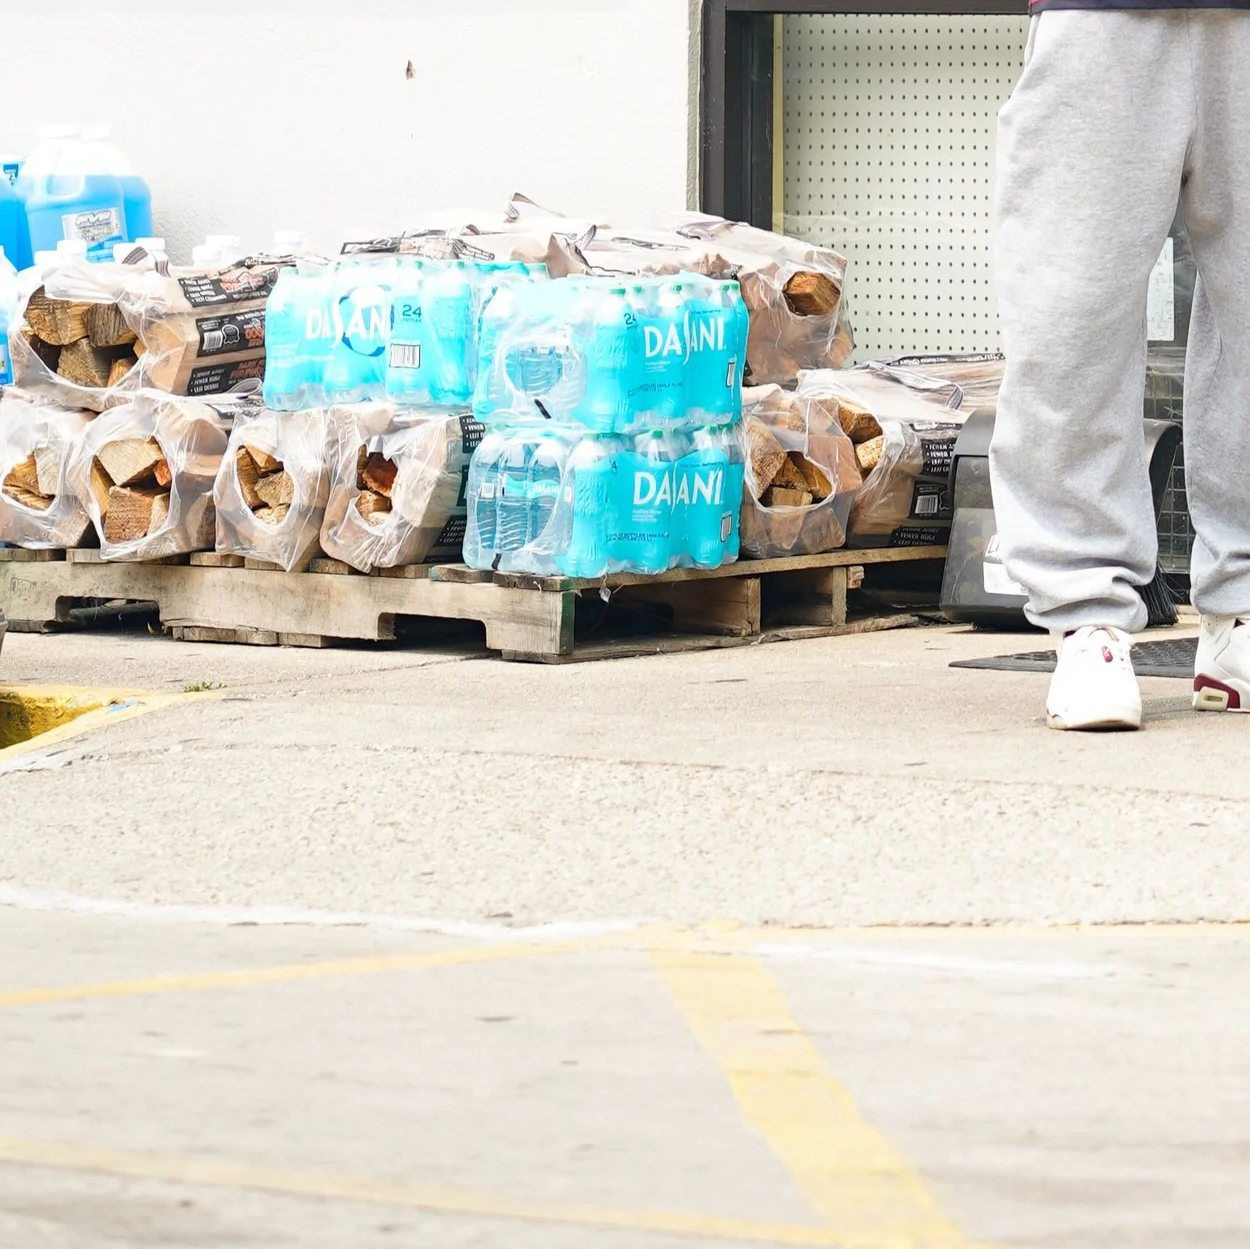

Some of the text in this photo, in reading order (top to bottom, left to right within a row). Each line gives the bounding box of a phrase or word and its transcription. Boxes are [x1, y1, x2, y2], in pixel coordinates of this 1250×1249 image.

[402, 304, 422, 317] 24
[643, 310, 725, 366] DASANI
[633, 466, 723, 514] DASANI
